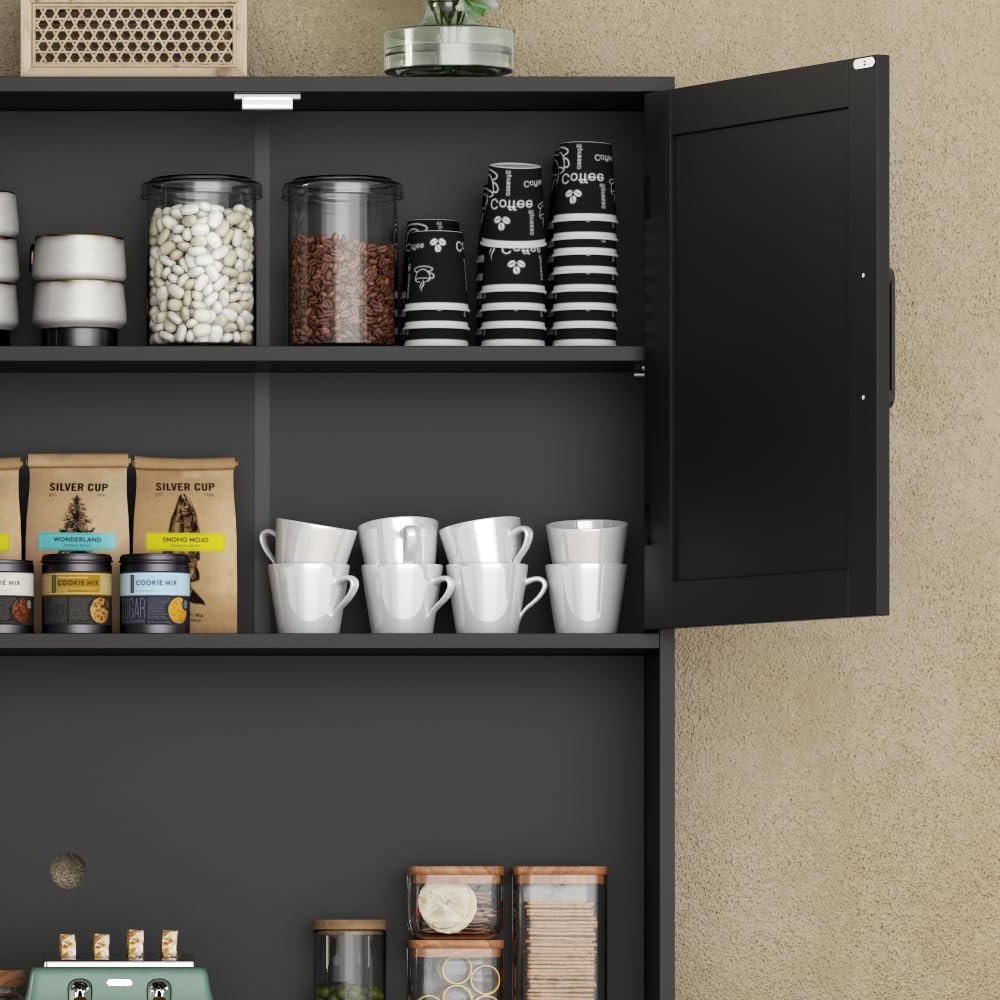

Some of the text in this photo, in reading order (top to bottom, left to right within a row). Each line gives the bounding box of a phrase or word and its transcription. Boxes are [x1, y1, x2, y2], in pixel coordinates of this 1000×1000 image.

[49, 482, 109, 492] SILVER CUP
[155, 482, 215, 492] SILVER CUP
